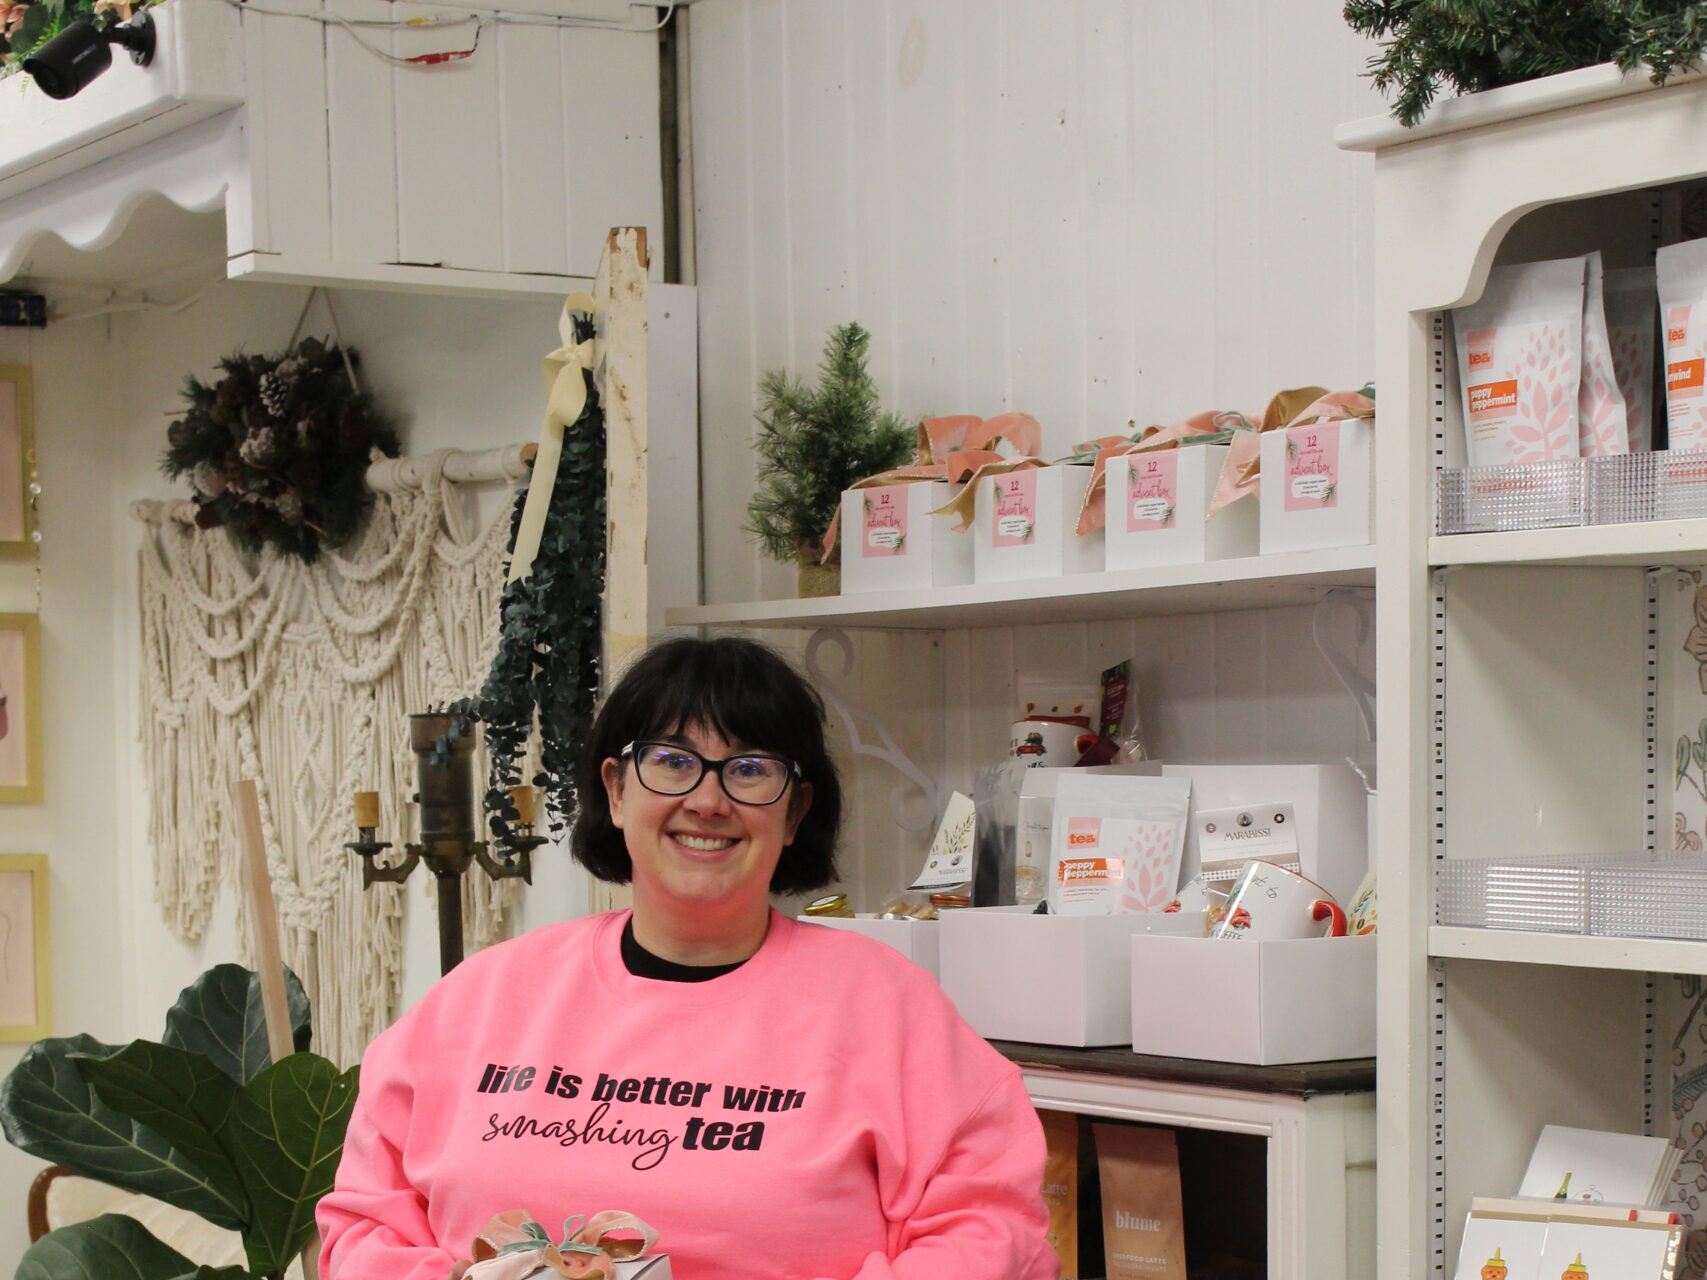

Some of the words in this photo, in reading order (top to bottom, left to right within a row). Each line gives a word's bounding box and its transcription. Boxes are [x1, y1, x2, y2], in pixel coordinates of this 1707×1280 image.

[1667, 328, 1686, 342] tea
[1468, 352, 1491, 366] tea
[1668, 367, 1692, 383] nwind
[1471, 387, 1493, 401] peppy
[1471, 392, 1516, 412] peppermint
[1307, 434, 1318, 448] 12
[1148, 460, 1158, 473] 12
[1010, 480, 1020, 491] 12
[881, 494, 890, 505] 12
[1069, 833, 1097, 845] tea
[1223, 827, 1272, 842] MARABISSI
[1064, 860, 1097, 871] peppy
[1064, 867, 1123, 880] peppermint
[477, 1063, 537, 1094] life
[544, 1065, 583, 1099] is
[591, 1073, 712, 1108] better
[722, 1085, 806, 1113] with
[481, 1102, 679, 1171] smashing
[681, 1117, 766, 1151] tea
[1115, 1210, 1161, 1232] blume
